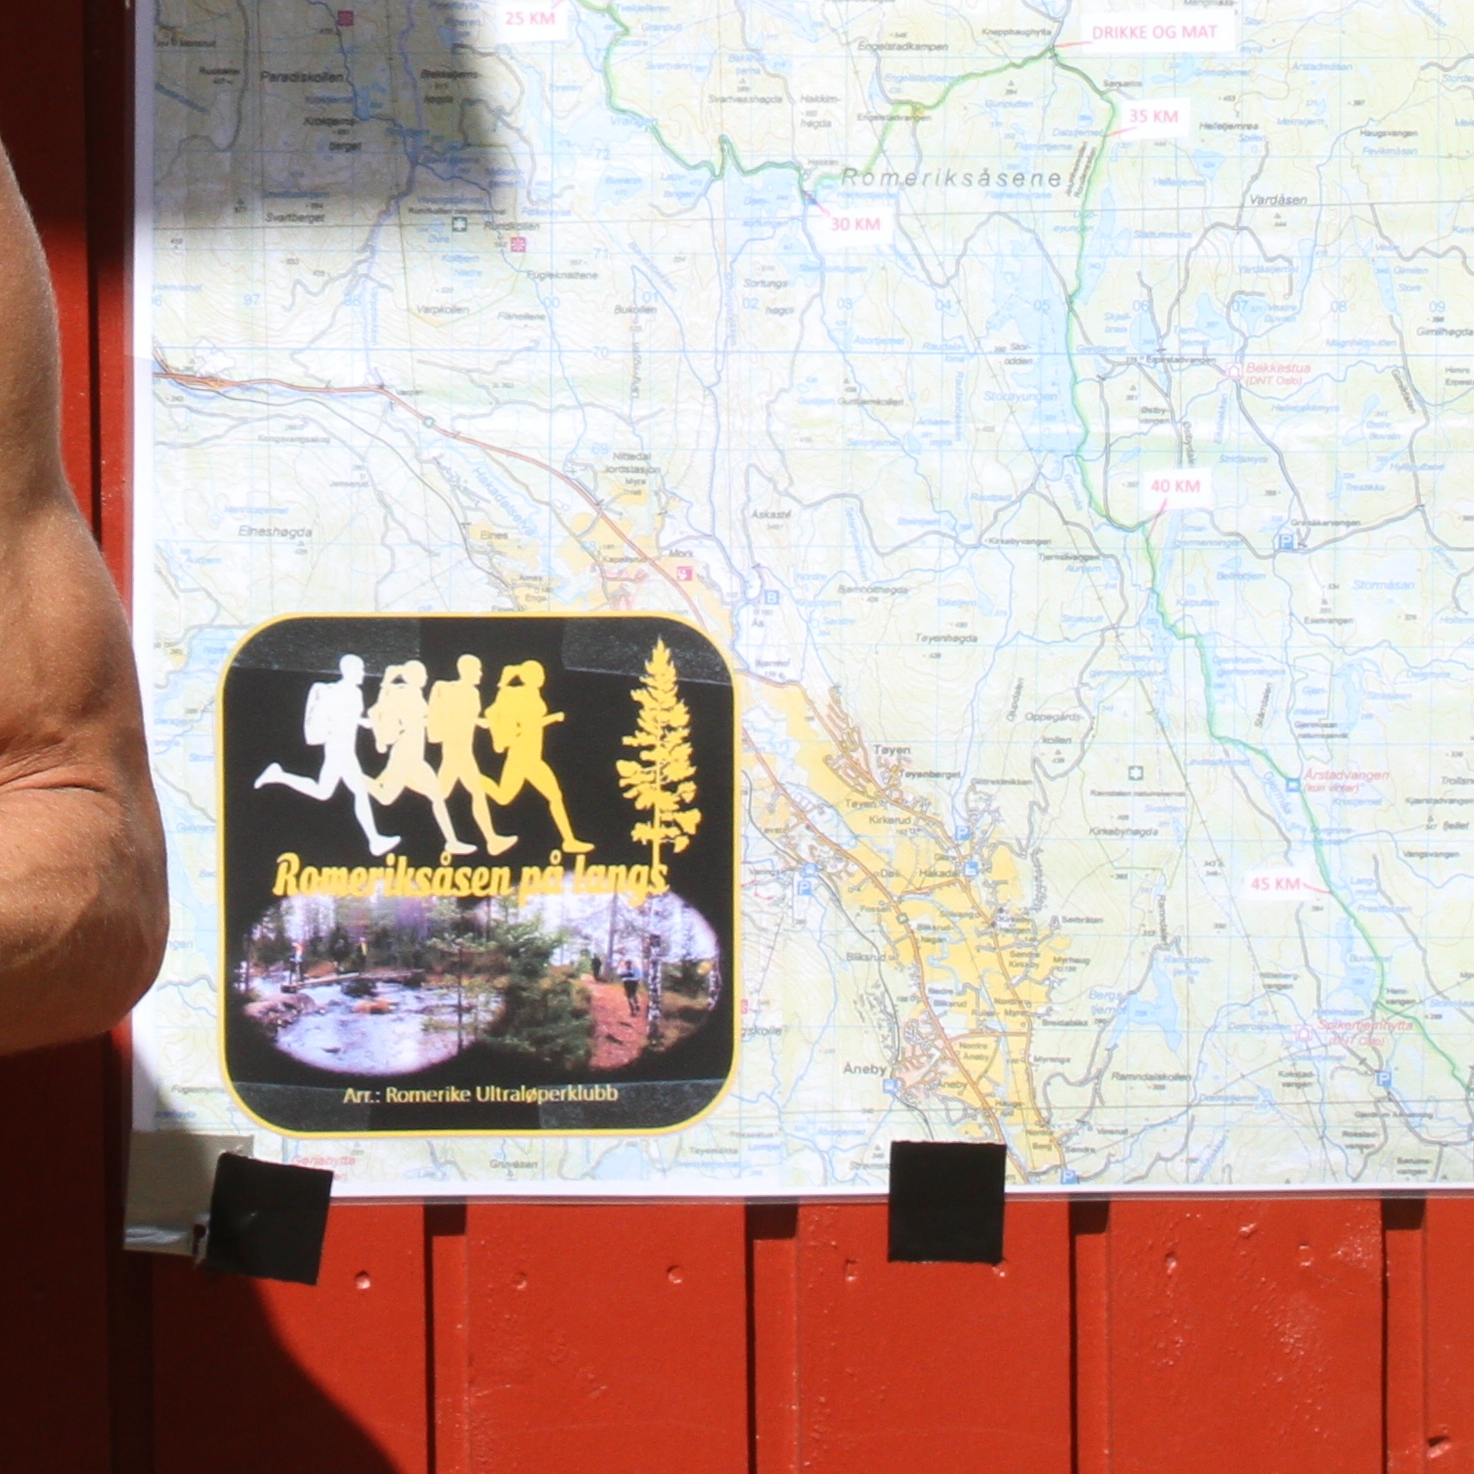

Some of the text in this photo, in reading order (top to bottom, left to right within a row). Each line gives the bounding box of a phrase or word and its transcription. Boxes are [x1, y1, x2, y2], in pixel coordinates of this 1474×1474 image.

[505, 12, 556, 25] 25 KM
[1092, 24, 1218, 41] DRIKKE OG MAT
[1129, 109, 1178, 124] 35 KM
[841, 166, 1062, 187] Romeriksåsene
[831, 217, 881, 231] 30 KM
[1429, 301, 1445, 312] 09
[1151, 480, 1201, 493] 40 KM
[874, 744, 911, 755] Tøyen
[272, 848, 669, 908] Romeriksåsen på langs
[1251, 876, 1300, 892] 45 KM
[843, 1062, 887, 1076] Åneby
[344, 1086, 618, 1104] Arr.: Romerike Ultraløperklubb
